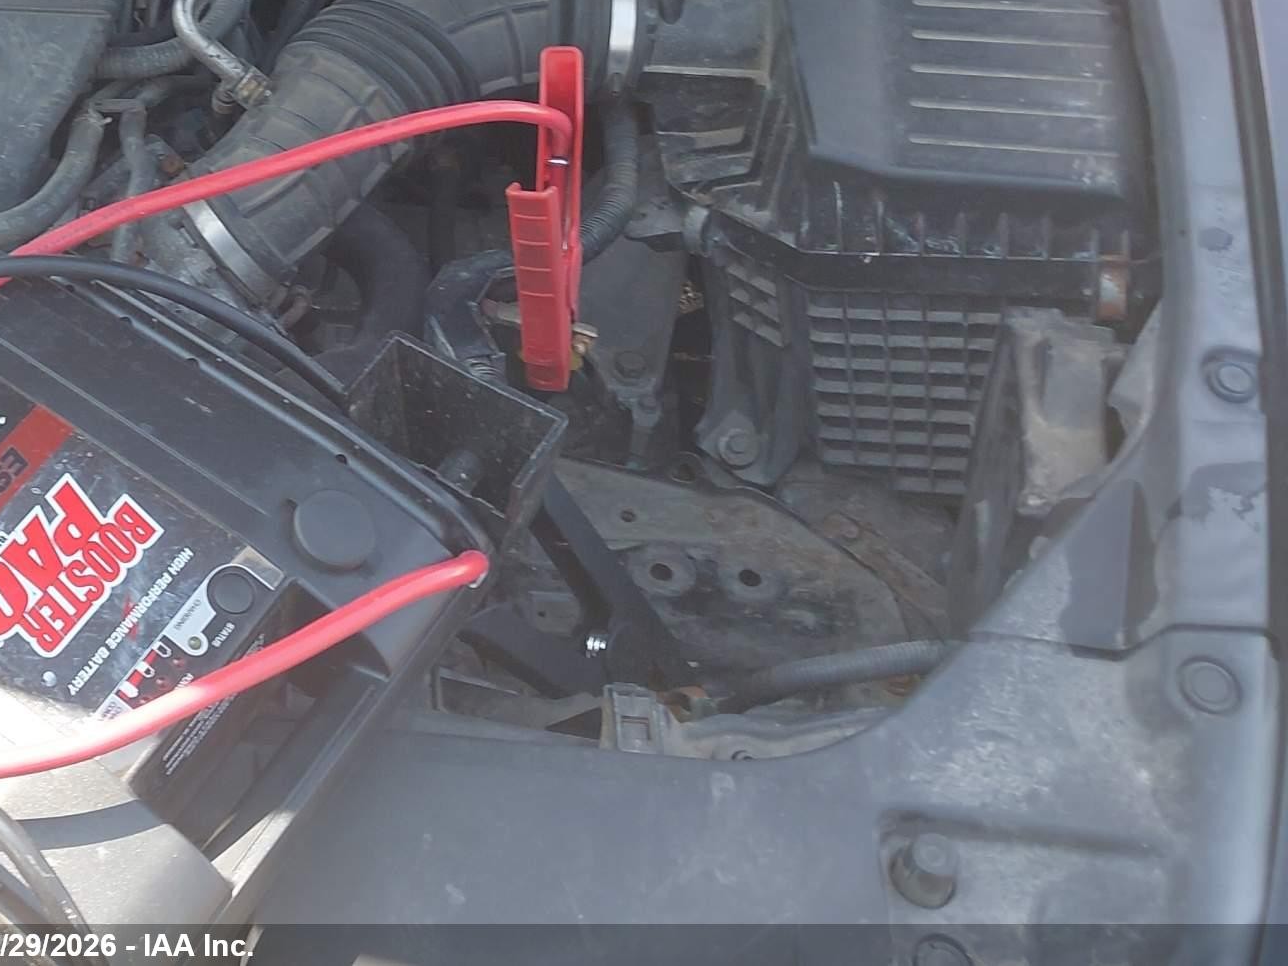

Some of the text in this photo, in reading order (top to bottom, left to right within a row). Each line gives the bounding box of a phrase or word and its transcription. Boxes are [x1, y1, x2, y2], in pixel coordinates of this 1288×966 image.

[17, 500, 157, 653] BOOSTER
[167, 546, 194, 576] HIGH
[104, 571, 173, 650] PERFORMANCE
[210, 620, 235, 648] STATUS
[67, 645, 109, 696] BATTERY
